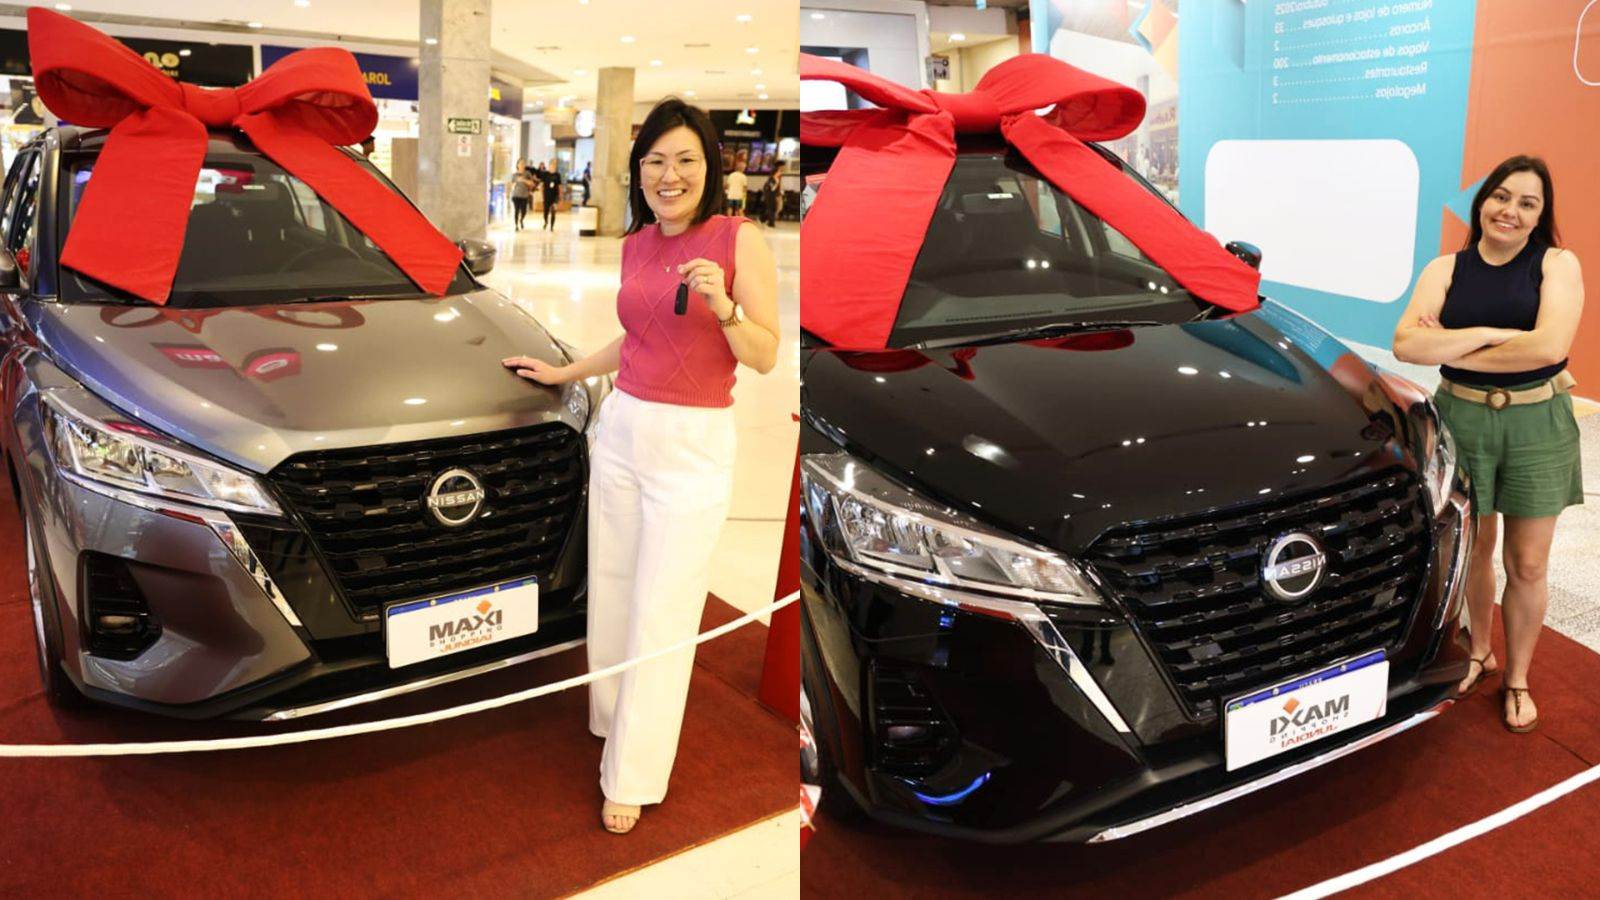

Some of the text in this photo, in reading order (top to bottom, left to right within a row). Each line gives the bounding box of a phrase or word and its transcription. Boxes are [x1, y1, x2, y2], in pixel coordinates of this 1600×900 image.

[427, 489, 485, 507] NISSAN
[429, 609, 503, 641] MAXI
[430, 625, 503, 647] SHOPPING
